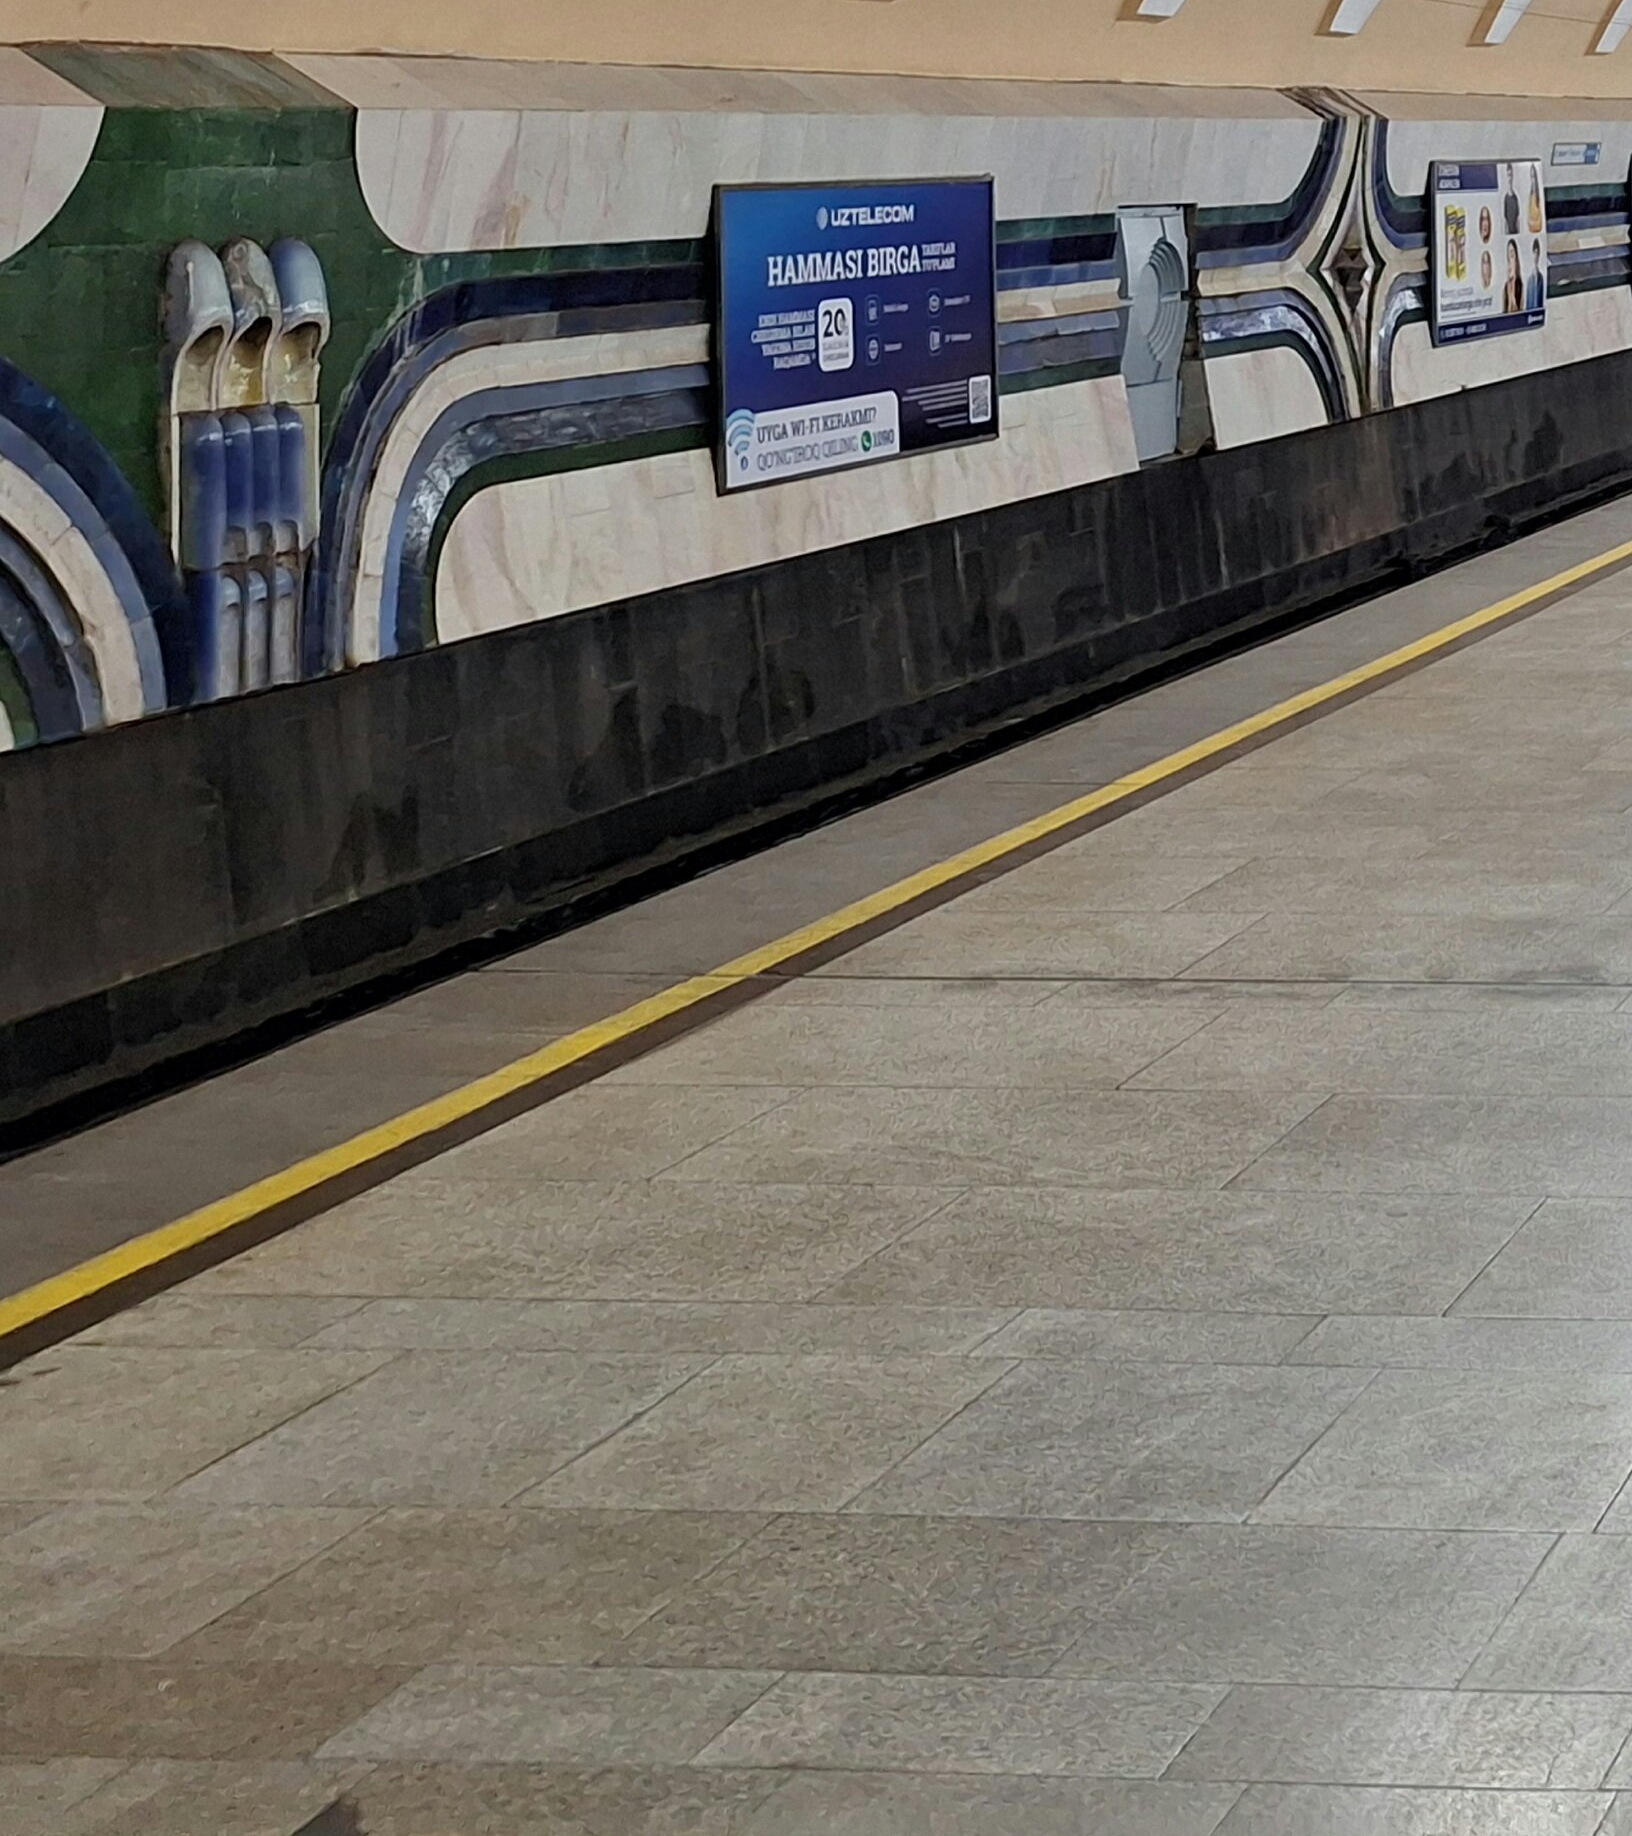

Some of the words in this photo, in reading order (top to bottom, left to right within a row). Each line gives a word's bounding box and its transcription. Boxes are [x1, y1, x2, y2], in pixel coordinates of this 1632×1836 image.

[830, 204, 915, 227] UZTELECOM
[767, 248, 864, 287] HAMMASI
[866, 244, 922, 278] BIRGA
[756, 422, 788, 444] UYGA
[790, 417, 819, 437] WI-FI
